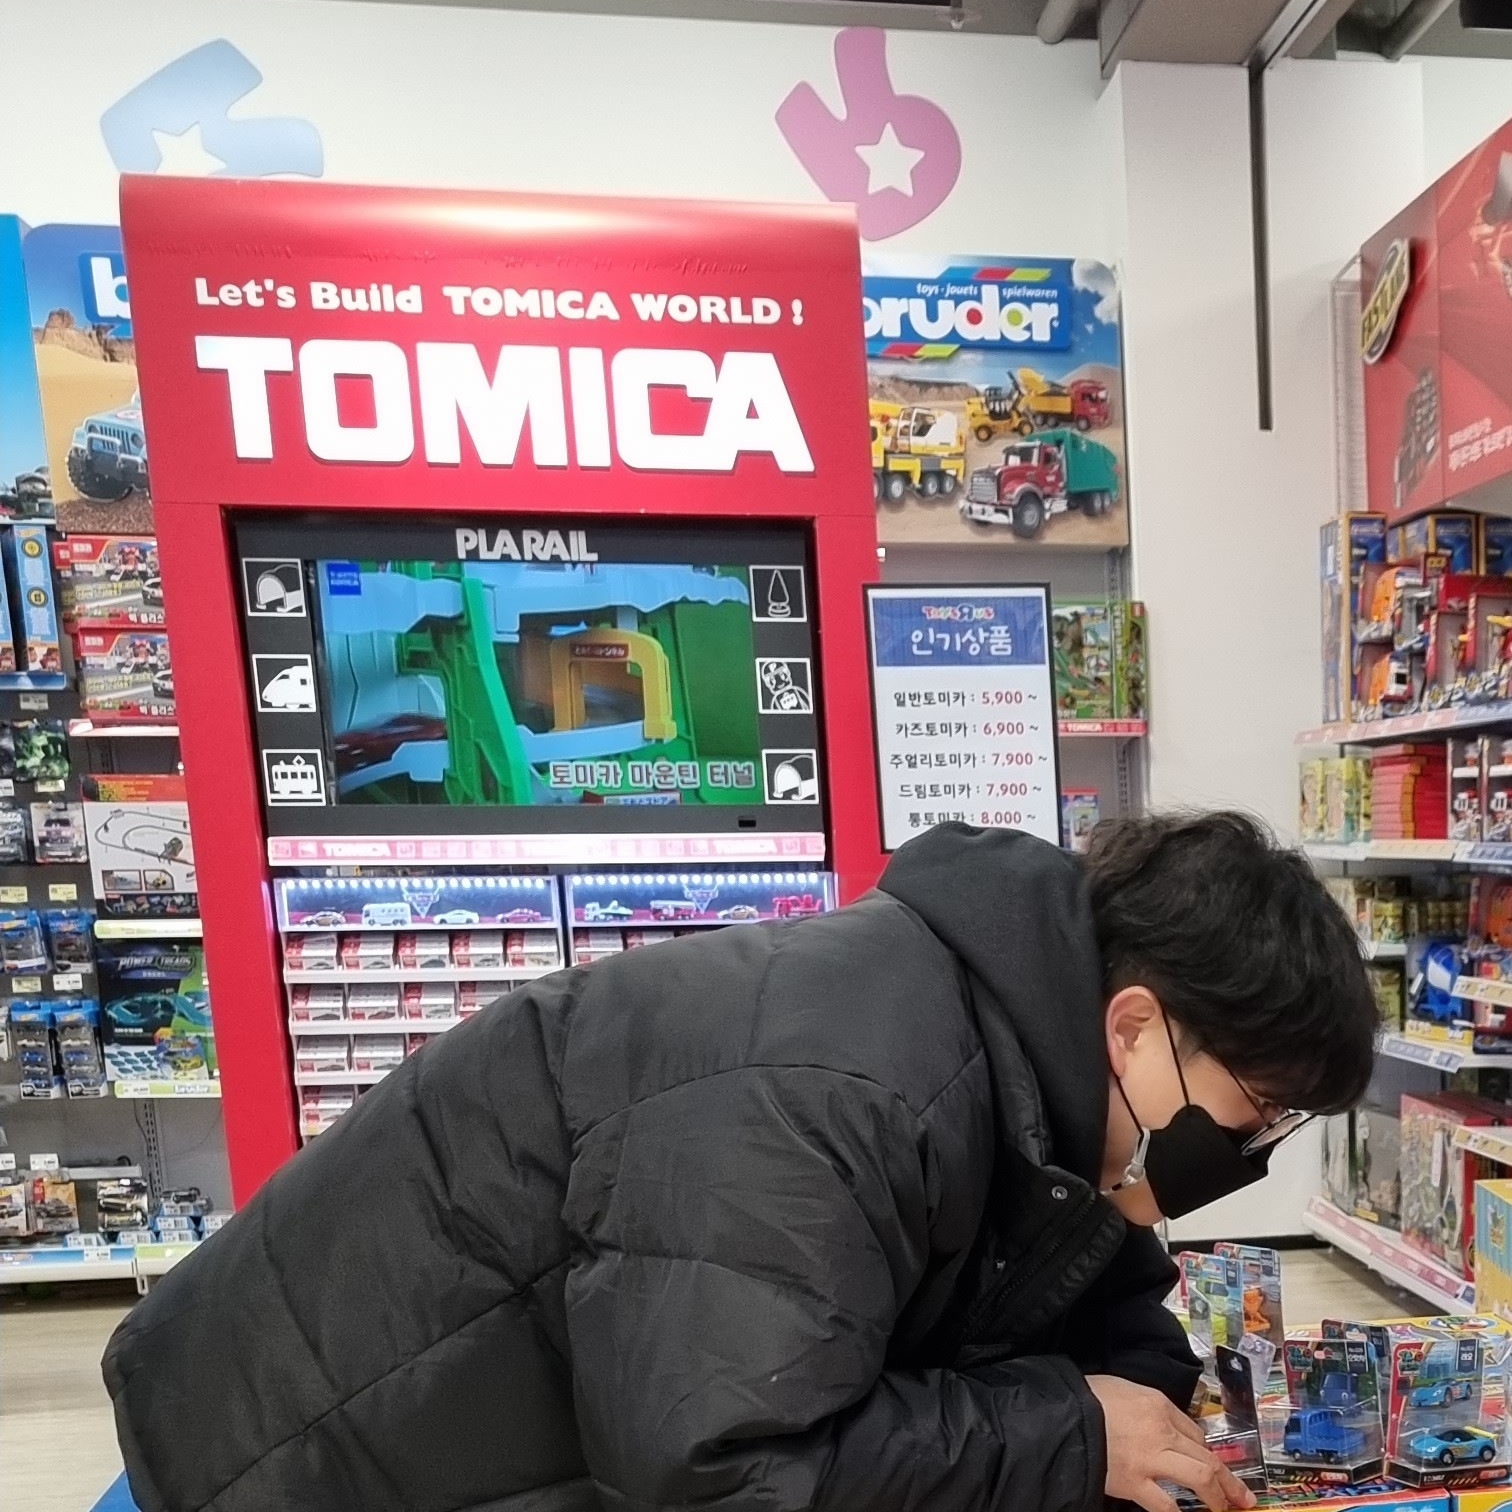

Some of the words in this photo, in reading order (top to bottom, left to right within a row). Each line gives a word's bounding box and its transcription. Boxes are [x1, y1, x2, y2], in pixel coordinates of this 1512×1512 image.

[194, 277, 297, 311] Let's
[309, 281, 423, 315] Build
[442, 286, 620, 321] TOMICA
[630, 293, 781, 326] WORLD
[194, 335, 815, 473] TOMICA
[911, 626, 1012, 656] 인기상품
[893, 692, 966, 708] 일반토미카
[981, 691, 1023, 707] 5,900
[895, 721, 969, 737] 카즈토미카
[982, 722, 1025, 737] 6,900
[889, 752, 978, 769] 주얼리토미카
[991, 752, 1034, 767] 7,900
[550, 761, 622, 788] 토미카
[628, 761, 700, 788] 마운틴
[706, 761, 755, 788] 터널
[898, 783, 972, 799] 드림토미카
[986, 783, 1028, 797] 7,900
[980, 811, 1022, 826] 8,000
